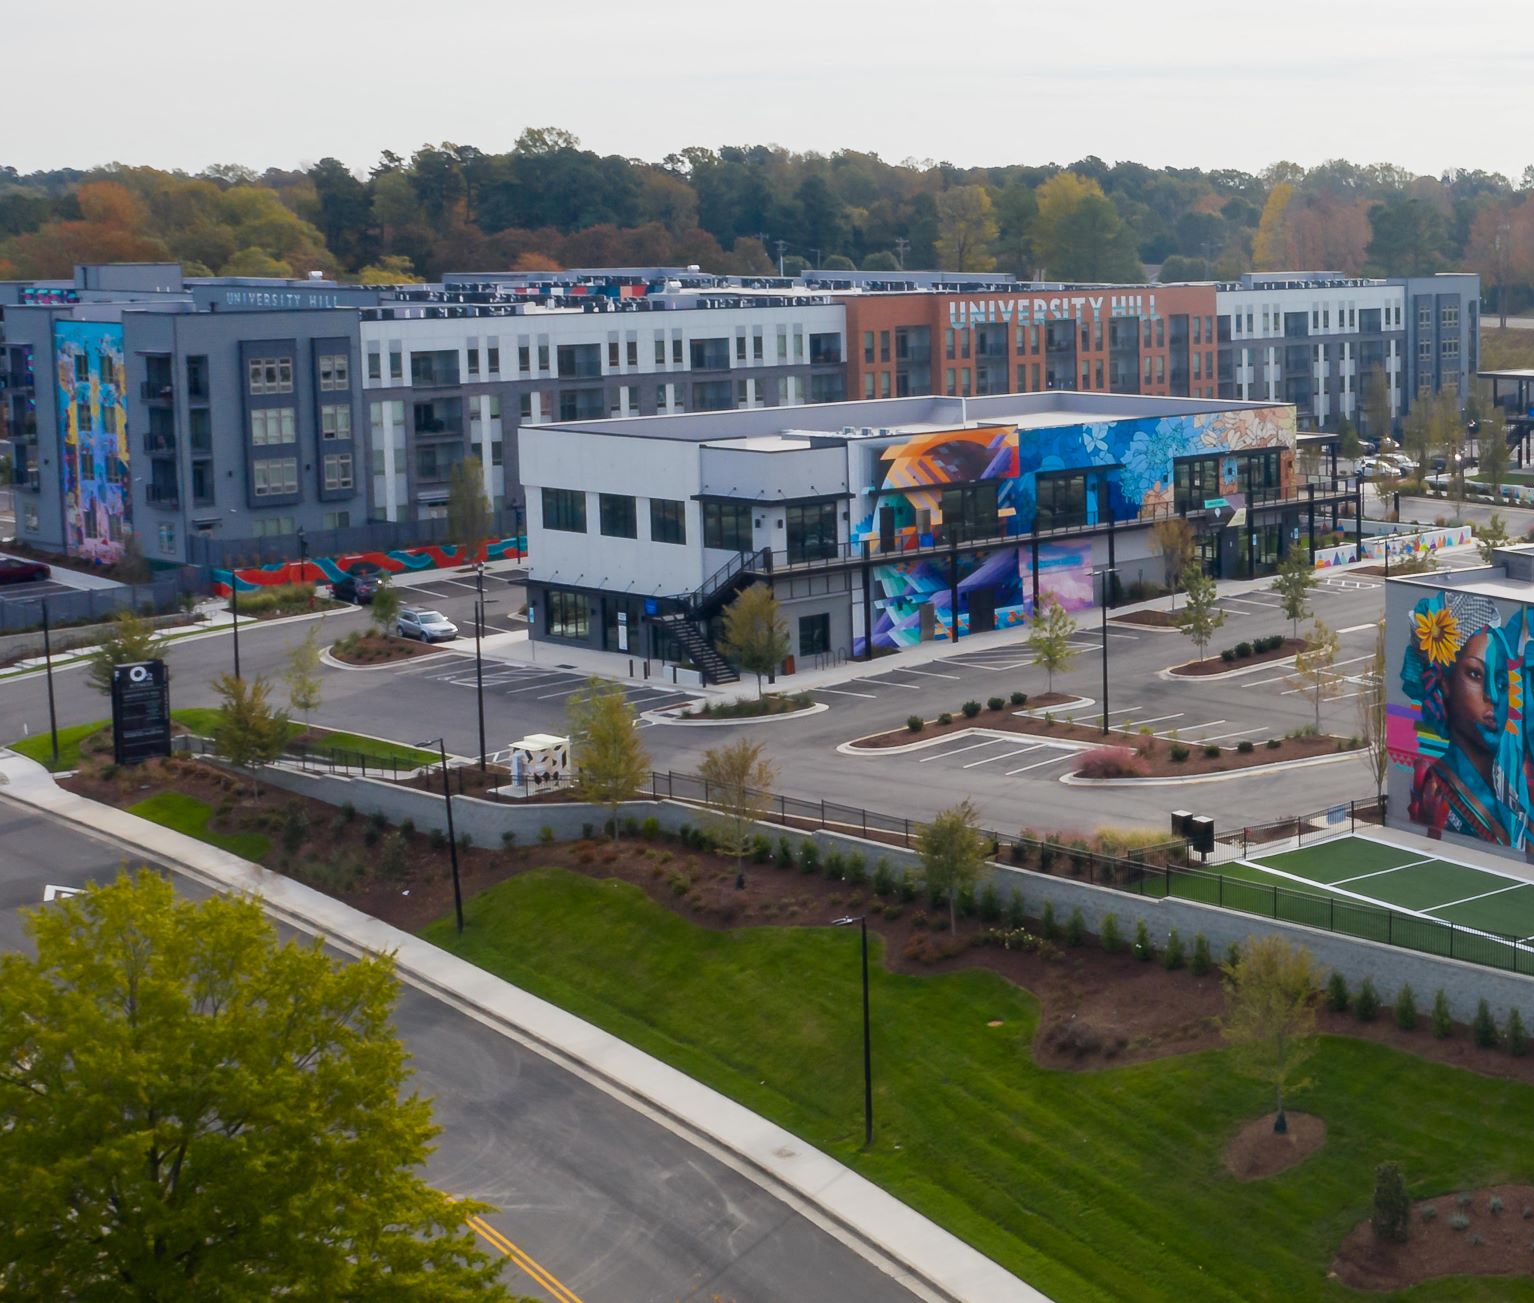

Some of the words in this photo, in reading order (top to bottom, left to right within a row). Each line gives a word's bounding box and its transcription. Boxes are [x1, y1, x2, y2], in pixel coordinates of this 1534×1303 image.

[226, 292, 300, 306] UNIVERSITY
[309, 296, 337, 308] HILL
[949, 296, 1103, 330] UNIVERSITY
[1111, 295, 1161, 321] HILL
